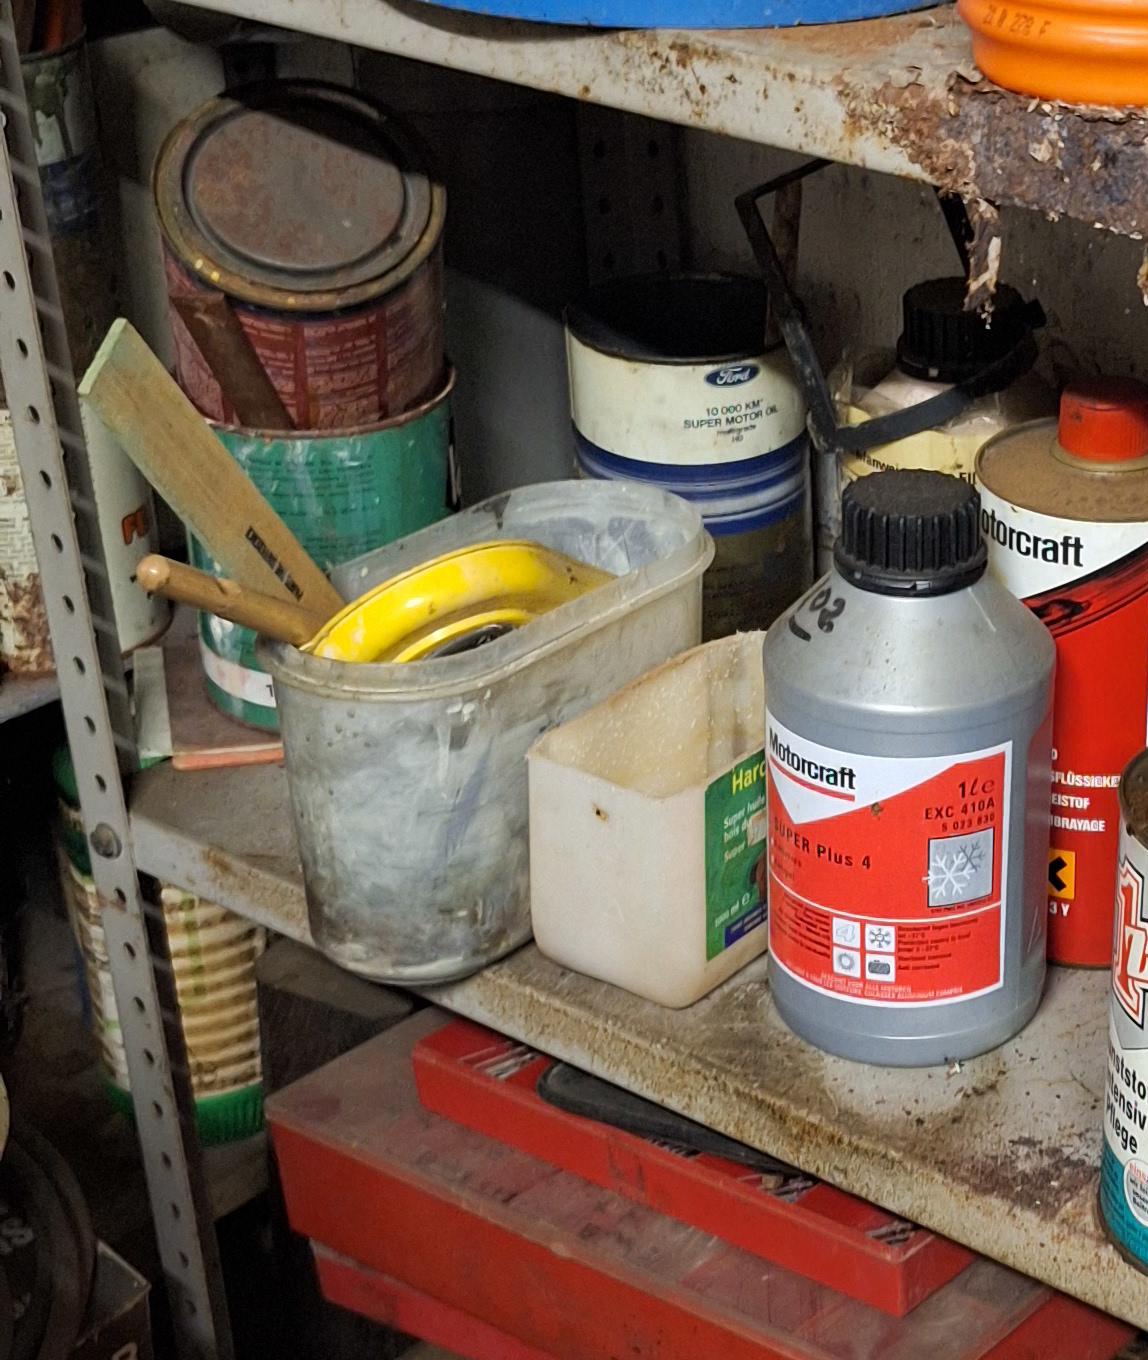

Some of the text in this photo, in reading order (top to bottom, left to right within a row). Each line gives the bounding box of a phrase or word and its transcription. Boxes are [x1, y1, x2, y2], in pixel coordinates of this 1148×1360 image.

[715, 366, 751, 385] Ford
[683, 404, 779, 429] SUPER MOTOR OIL
[706, 403, 742, 417] 10 000
[981, 506, 1085, 568] otorcraft
[769, 727, 857, 790] Motorcraft
[924, 797, 996, 821] EXC 410A
[1051, 795, 1091, 811] EISTOF
[1050, 815, 1107, 833] BRAYAGE
[773, 815, 811, 853] SUPER
[816, 844, 854, 868] Plus
[861, 855, 872, 870] 4
[1106, 1099, 1139, 1155] Pflege
